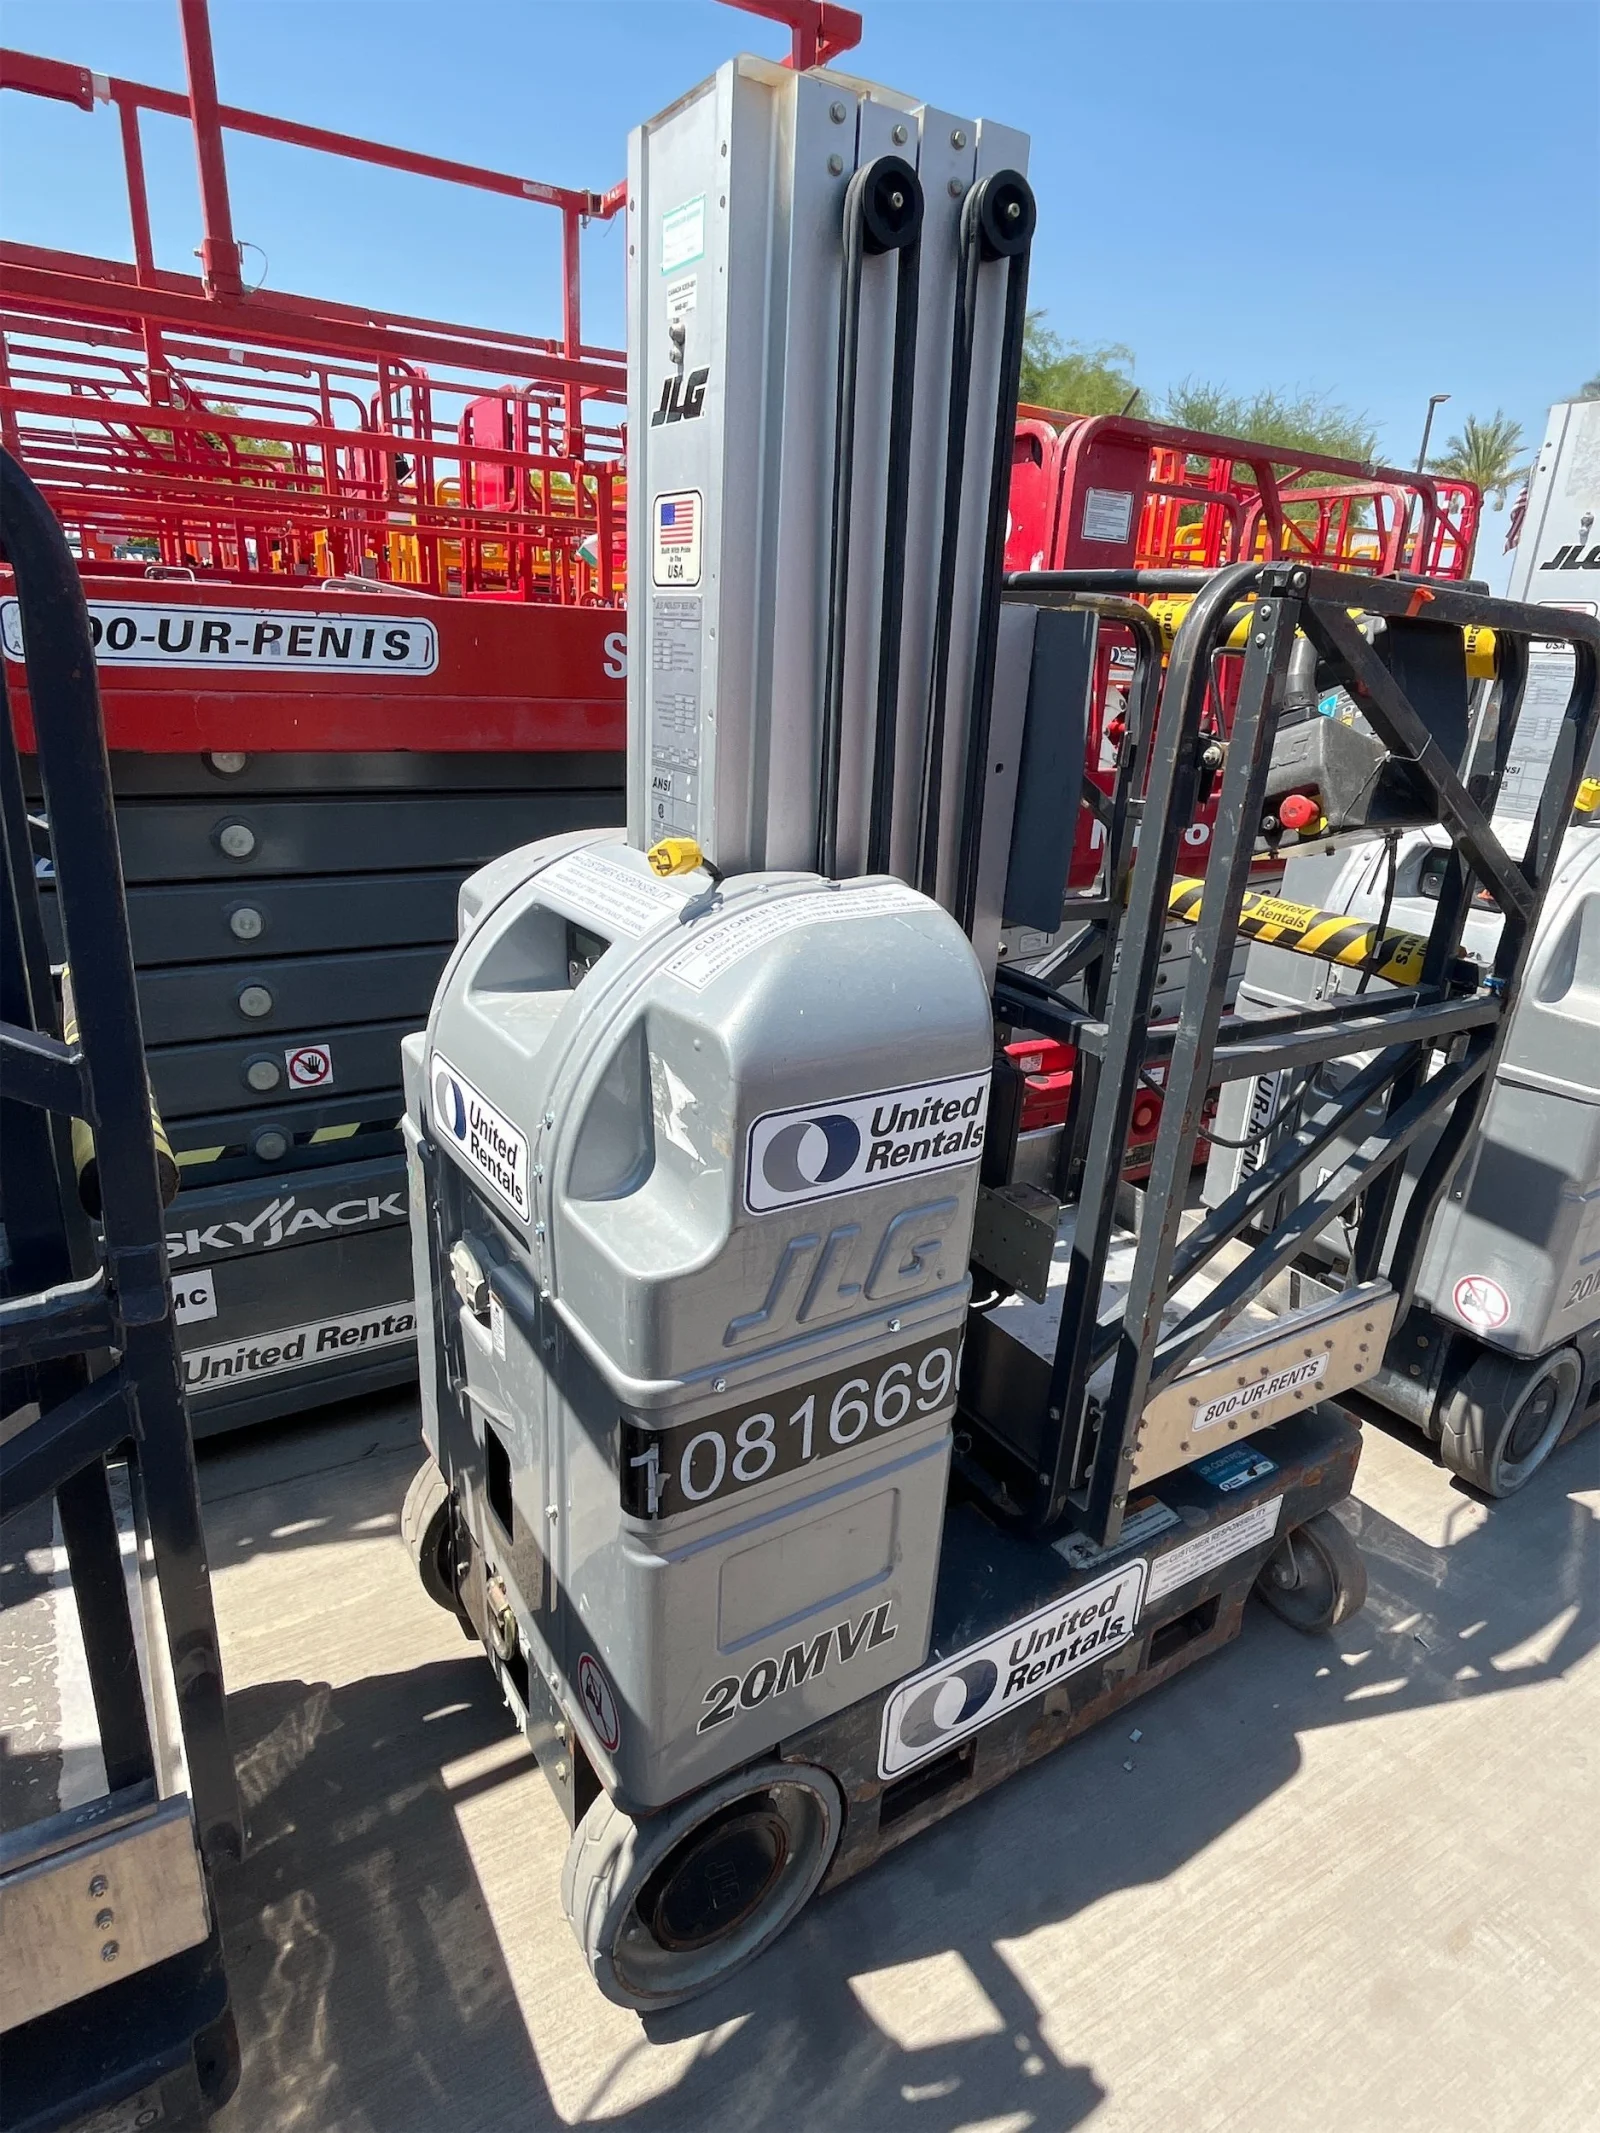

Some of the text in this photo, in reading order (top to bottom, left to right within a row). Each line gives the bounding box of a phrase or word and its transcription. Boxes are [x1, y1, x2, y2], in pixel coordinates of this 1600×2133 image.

[651, 368, 710, 427] JLG
[667, 565, 684, 578] USA
[652, 776, 671, 792] ANSI
[695, 907, 768, 951] CUSTOMER
[1256, 905, 1307, 928] Rentals
[1264, 898, 1313, 915] United
[470, 1100, 519, 1171] United
[870, 1086, 984, 1138] United
[469, 1134, 524, 1206] Rentals
[865, 1121, 984, 1174] Rentals
[165, 1192, 407, 1259] SKYJACK
[722, 1195, 960, 1348] JLG
[184, 1313, 418, 1385] United Renta
[1204, 1360, 1319, 1422] 800-UR-RENTS
[1008, 1584, 1122, 1667] United
[697, 1600, 900, 1735] 20MVL
[1002, 1614, 1127, 1700] Rentals
